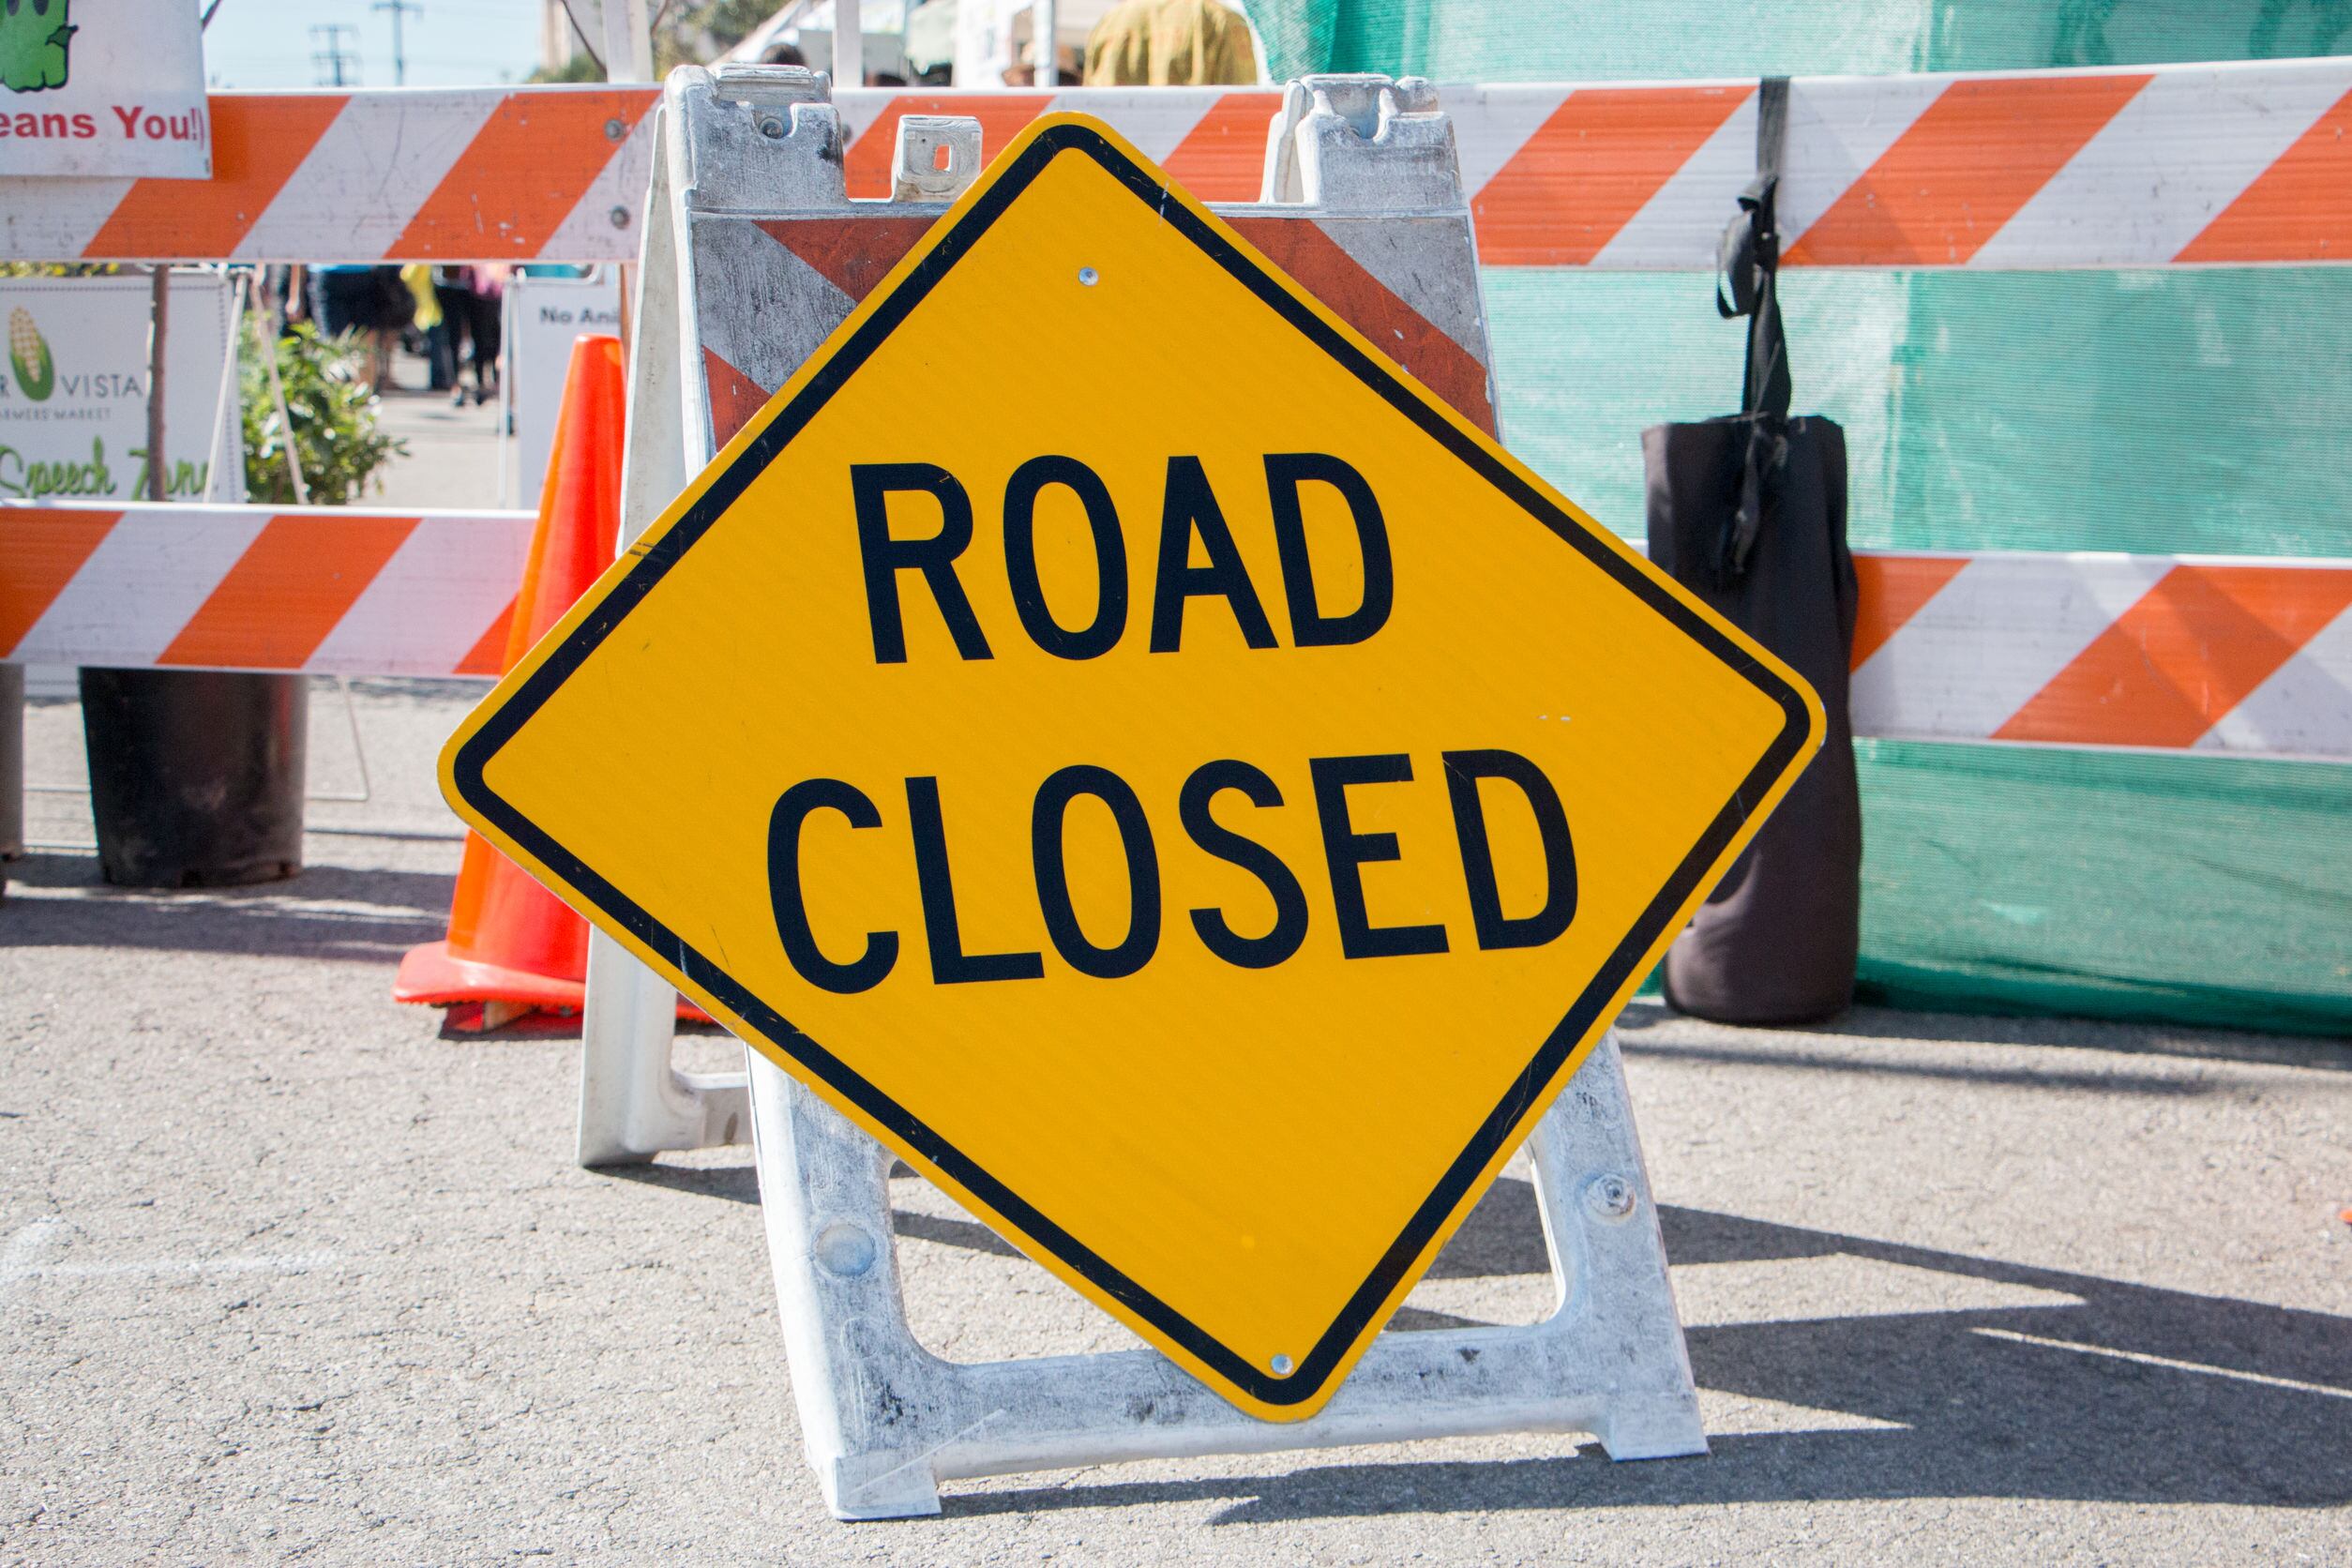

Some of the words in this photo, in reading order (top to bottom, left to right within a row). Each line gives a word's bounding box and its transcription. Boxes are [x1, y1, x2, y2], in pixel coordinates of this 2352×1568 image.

[539, 307, 573, 323] No
[60, 374, 143, 398] VISTA
[851, 453, 1393, 663] ROAD
[768, 749, 1577, 994] CLOSED
